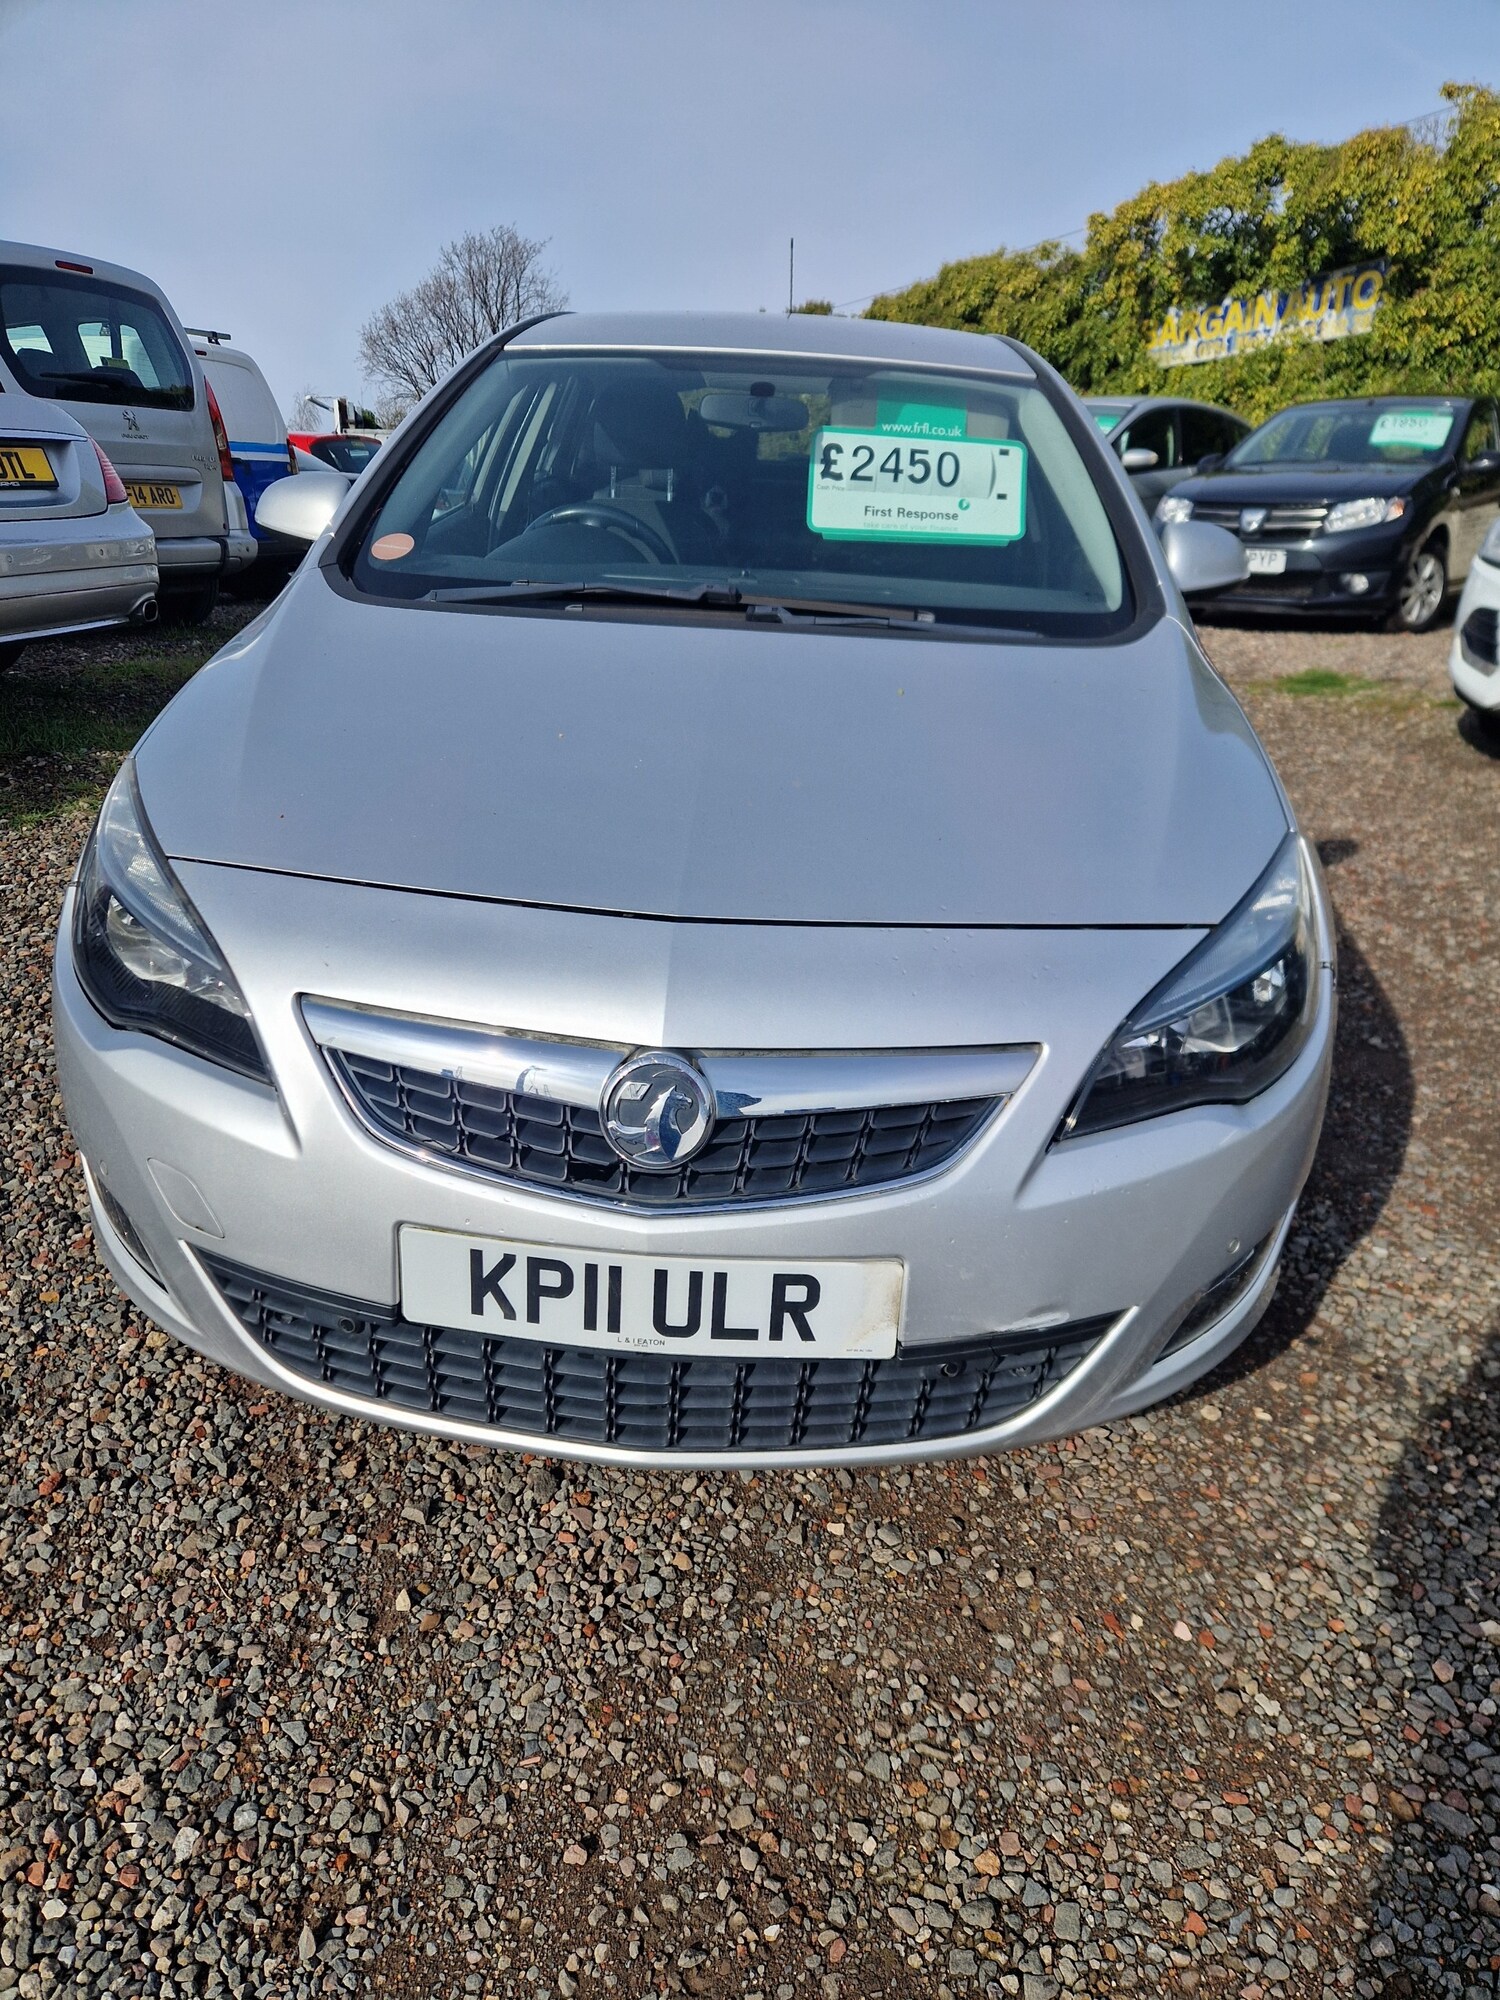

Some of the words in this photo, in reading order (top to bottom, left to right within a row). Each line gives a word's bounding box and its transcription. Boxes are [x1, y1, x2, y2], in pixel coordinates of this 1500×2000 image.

[882, 422, 962, 437] www.frfl.co.uk
[819, 442, 961, 488] £2450
[864, 505, 892, 518] First
[897, 507, 959, 521] Response
[863, 521, 880, 529] take
[881, 522, 898, 530] care
[900, 521, 909, 530] of
[910, 523, 928, 532] your
[929, 522, 959, 532] finance
[469, 1248, 623, 1334] KP11
[652, 1268, 822, 1343] ULR
[637, 1338, 666, 1346] EATON
